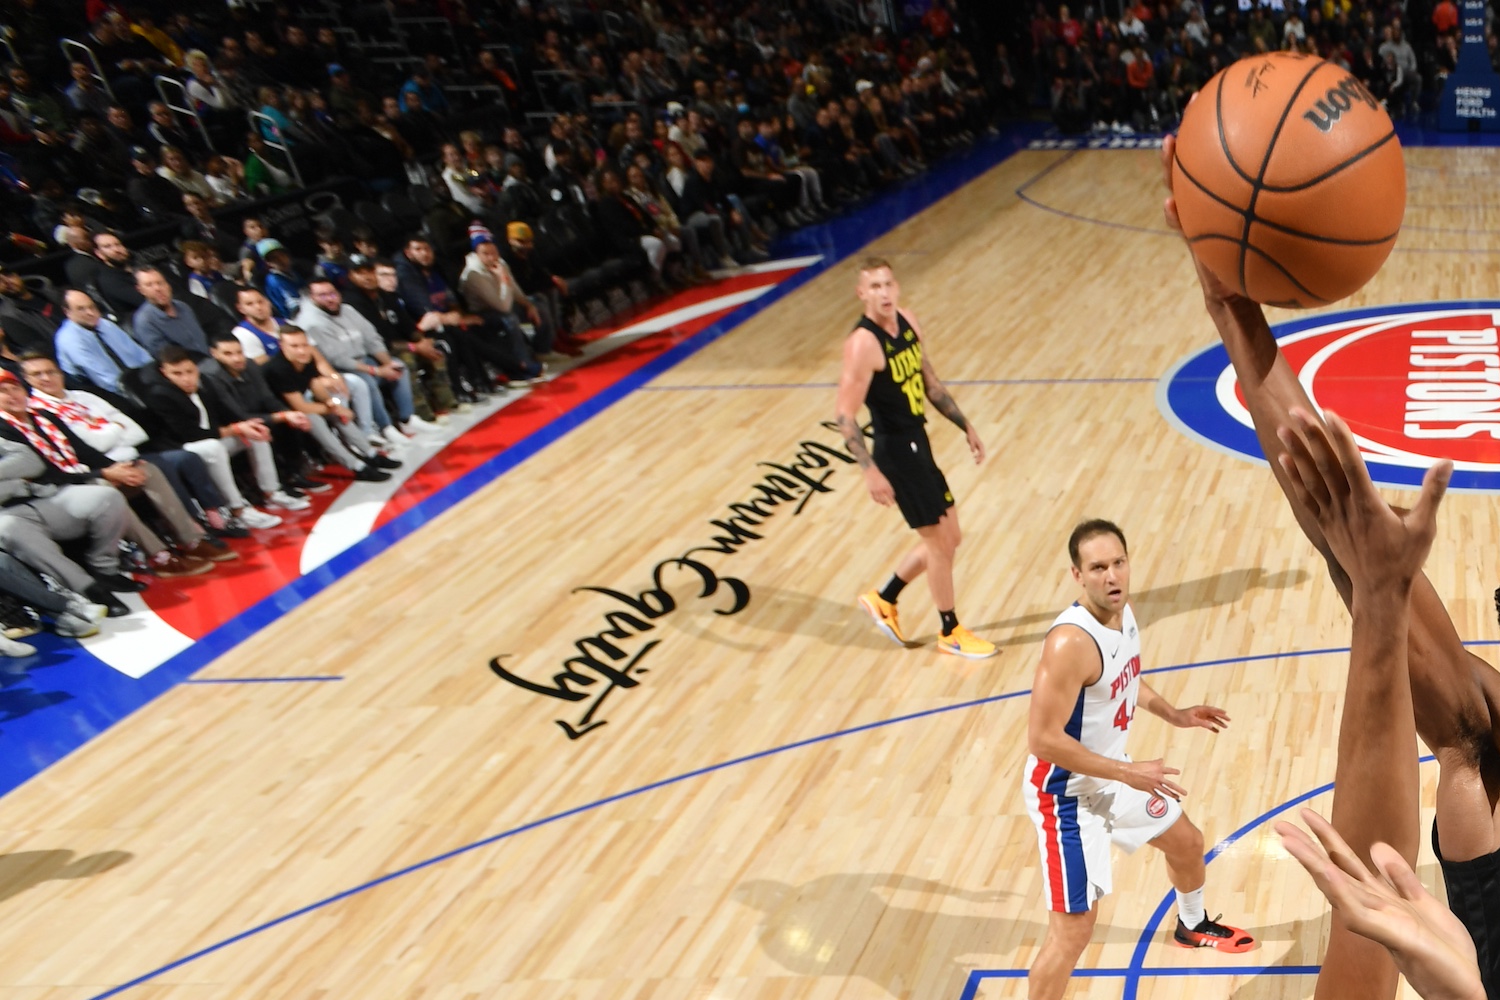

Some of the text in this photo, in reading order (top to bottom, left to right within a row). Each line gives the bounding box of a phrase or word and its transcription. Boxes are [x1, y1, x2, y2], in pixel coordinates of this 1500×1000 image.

[1303, 73, 1379, 134] lson
[1455, 87, 1491, 99] HENRY
[901, 372, 925, 416] 19
